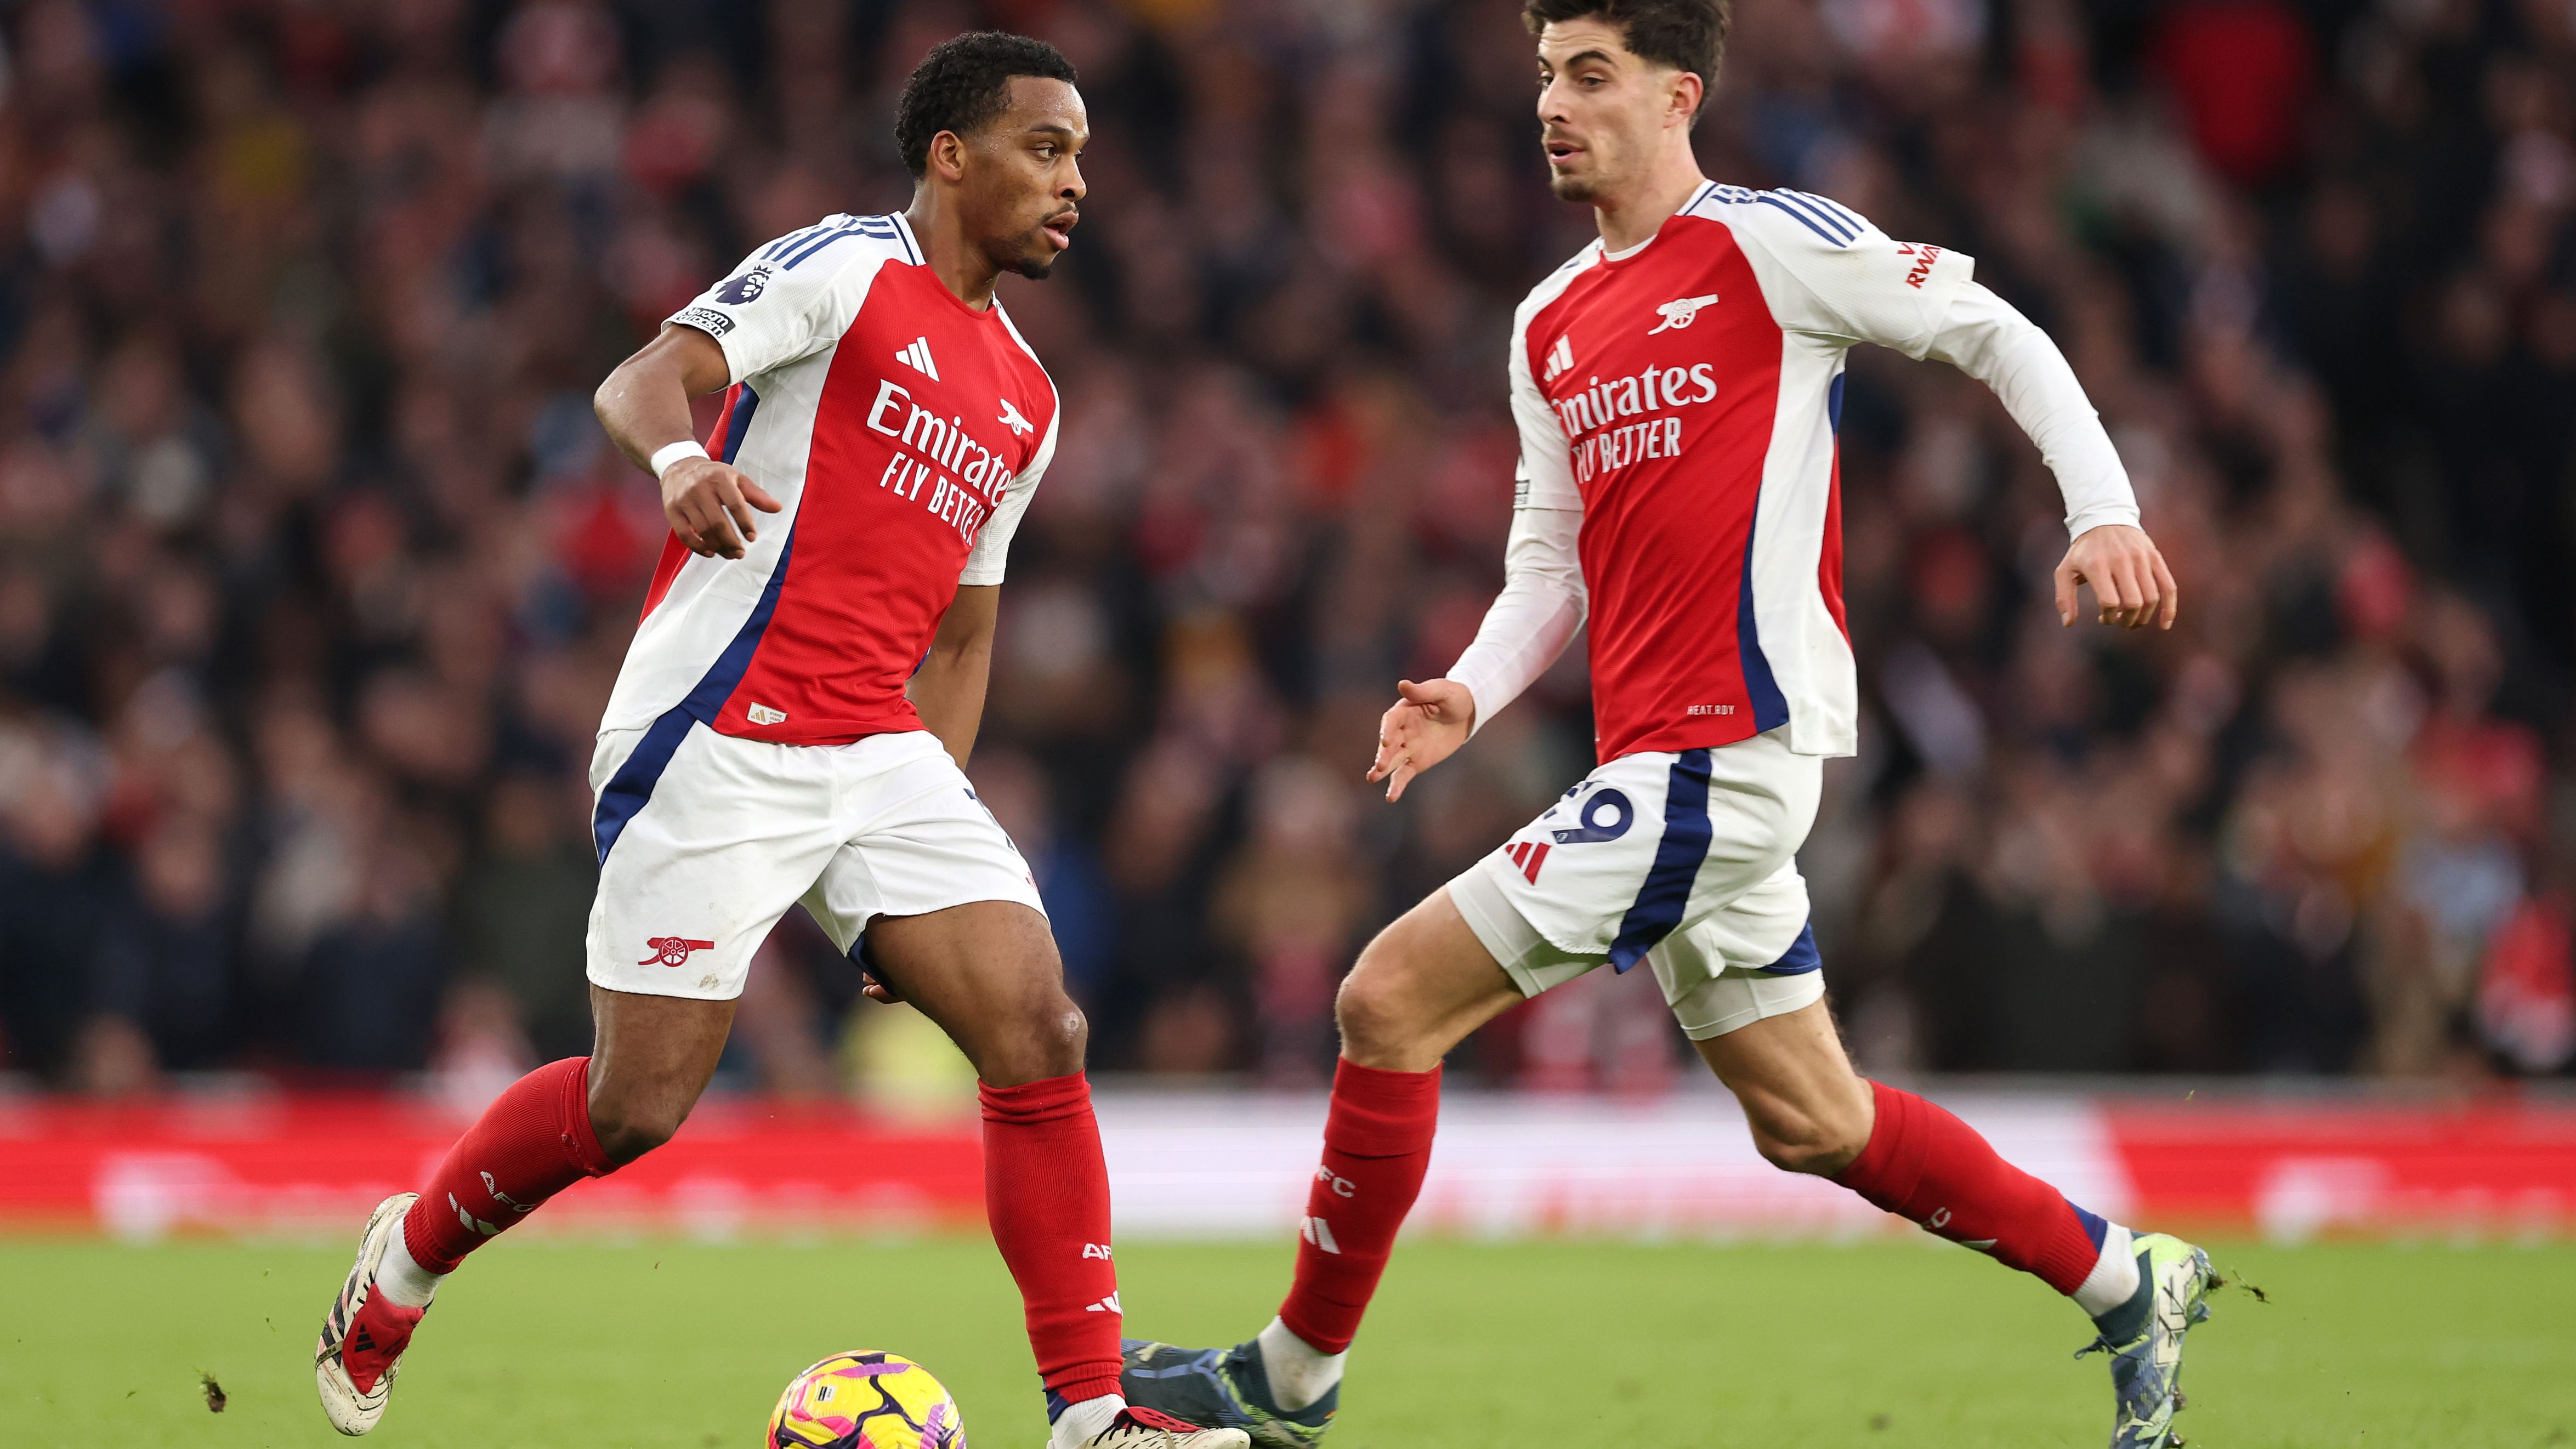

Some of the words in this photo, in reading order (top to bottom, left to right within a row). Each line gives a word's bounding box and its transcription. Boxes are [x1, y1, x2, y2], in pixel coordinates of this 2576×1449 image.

[1905, 246, 1941, 289] RWA
[688, 314, 725, 338] racism
[697, 310, 729, 327] room
[1551, 363, 1717, 439] mirates
[867, 378, 1013, 508] Emirate
[1597, 417, 1682, 473] BETTER
[879, 451, 931, 502] FLY
[1543, 781, 1634, 844] 9
[1319, 1164, 1356, 1198] FC
[1082, 1242, 1112, 1260] AF
